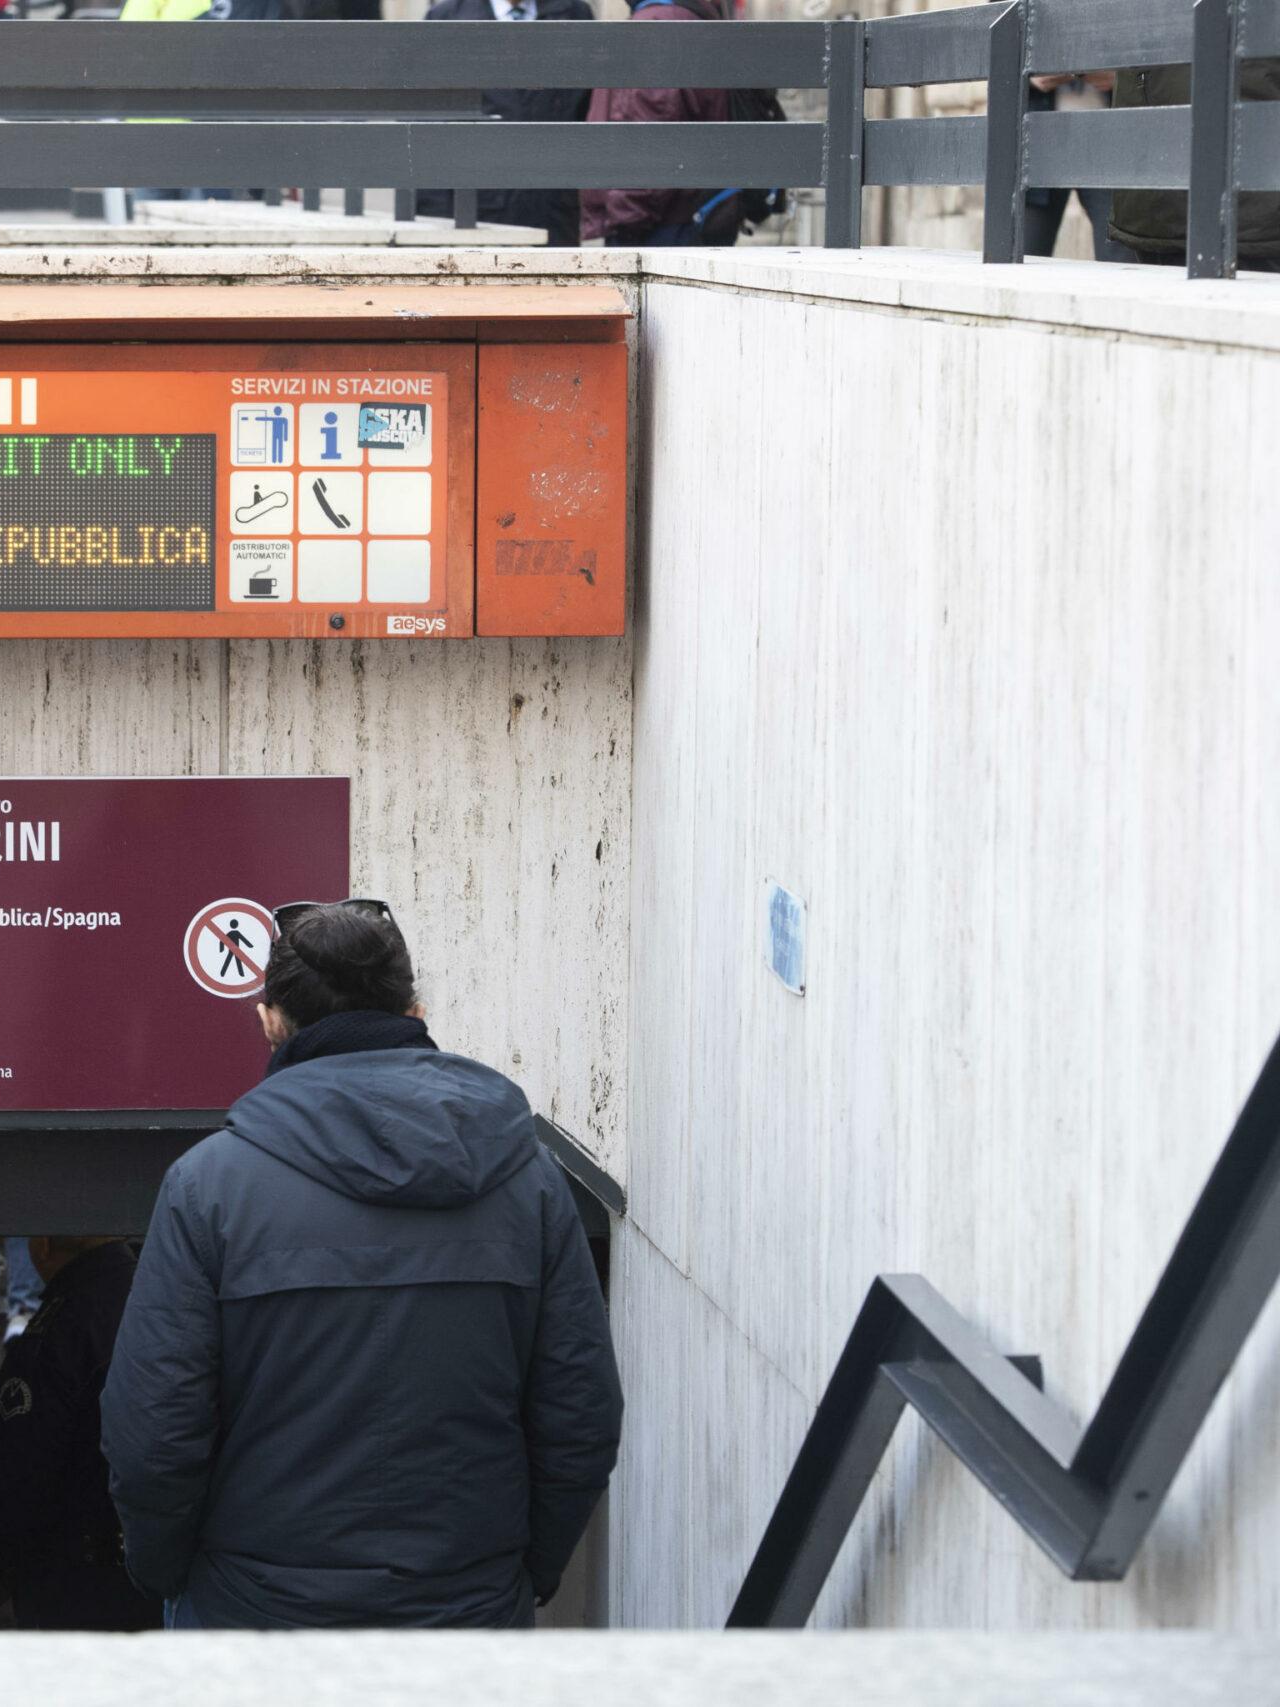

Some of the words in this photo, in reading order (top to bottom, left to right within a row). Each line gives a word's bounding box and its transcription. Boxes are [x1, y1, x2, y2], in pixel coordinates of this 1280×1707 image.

[231, 378, 306, 395] SERVIZI
[312, 378, 331, 395] IN
[336, 378, 433, 395] STAZIONE
[70, 436, 182, 475] ONLY
[232, 543, 291, 551] DISTRIBUTORI
[236, 552, 287, 560] AUTOMATICI
[392, 616, 447, 634] aesys
